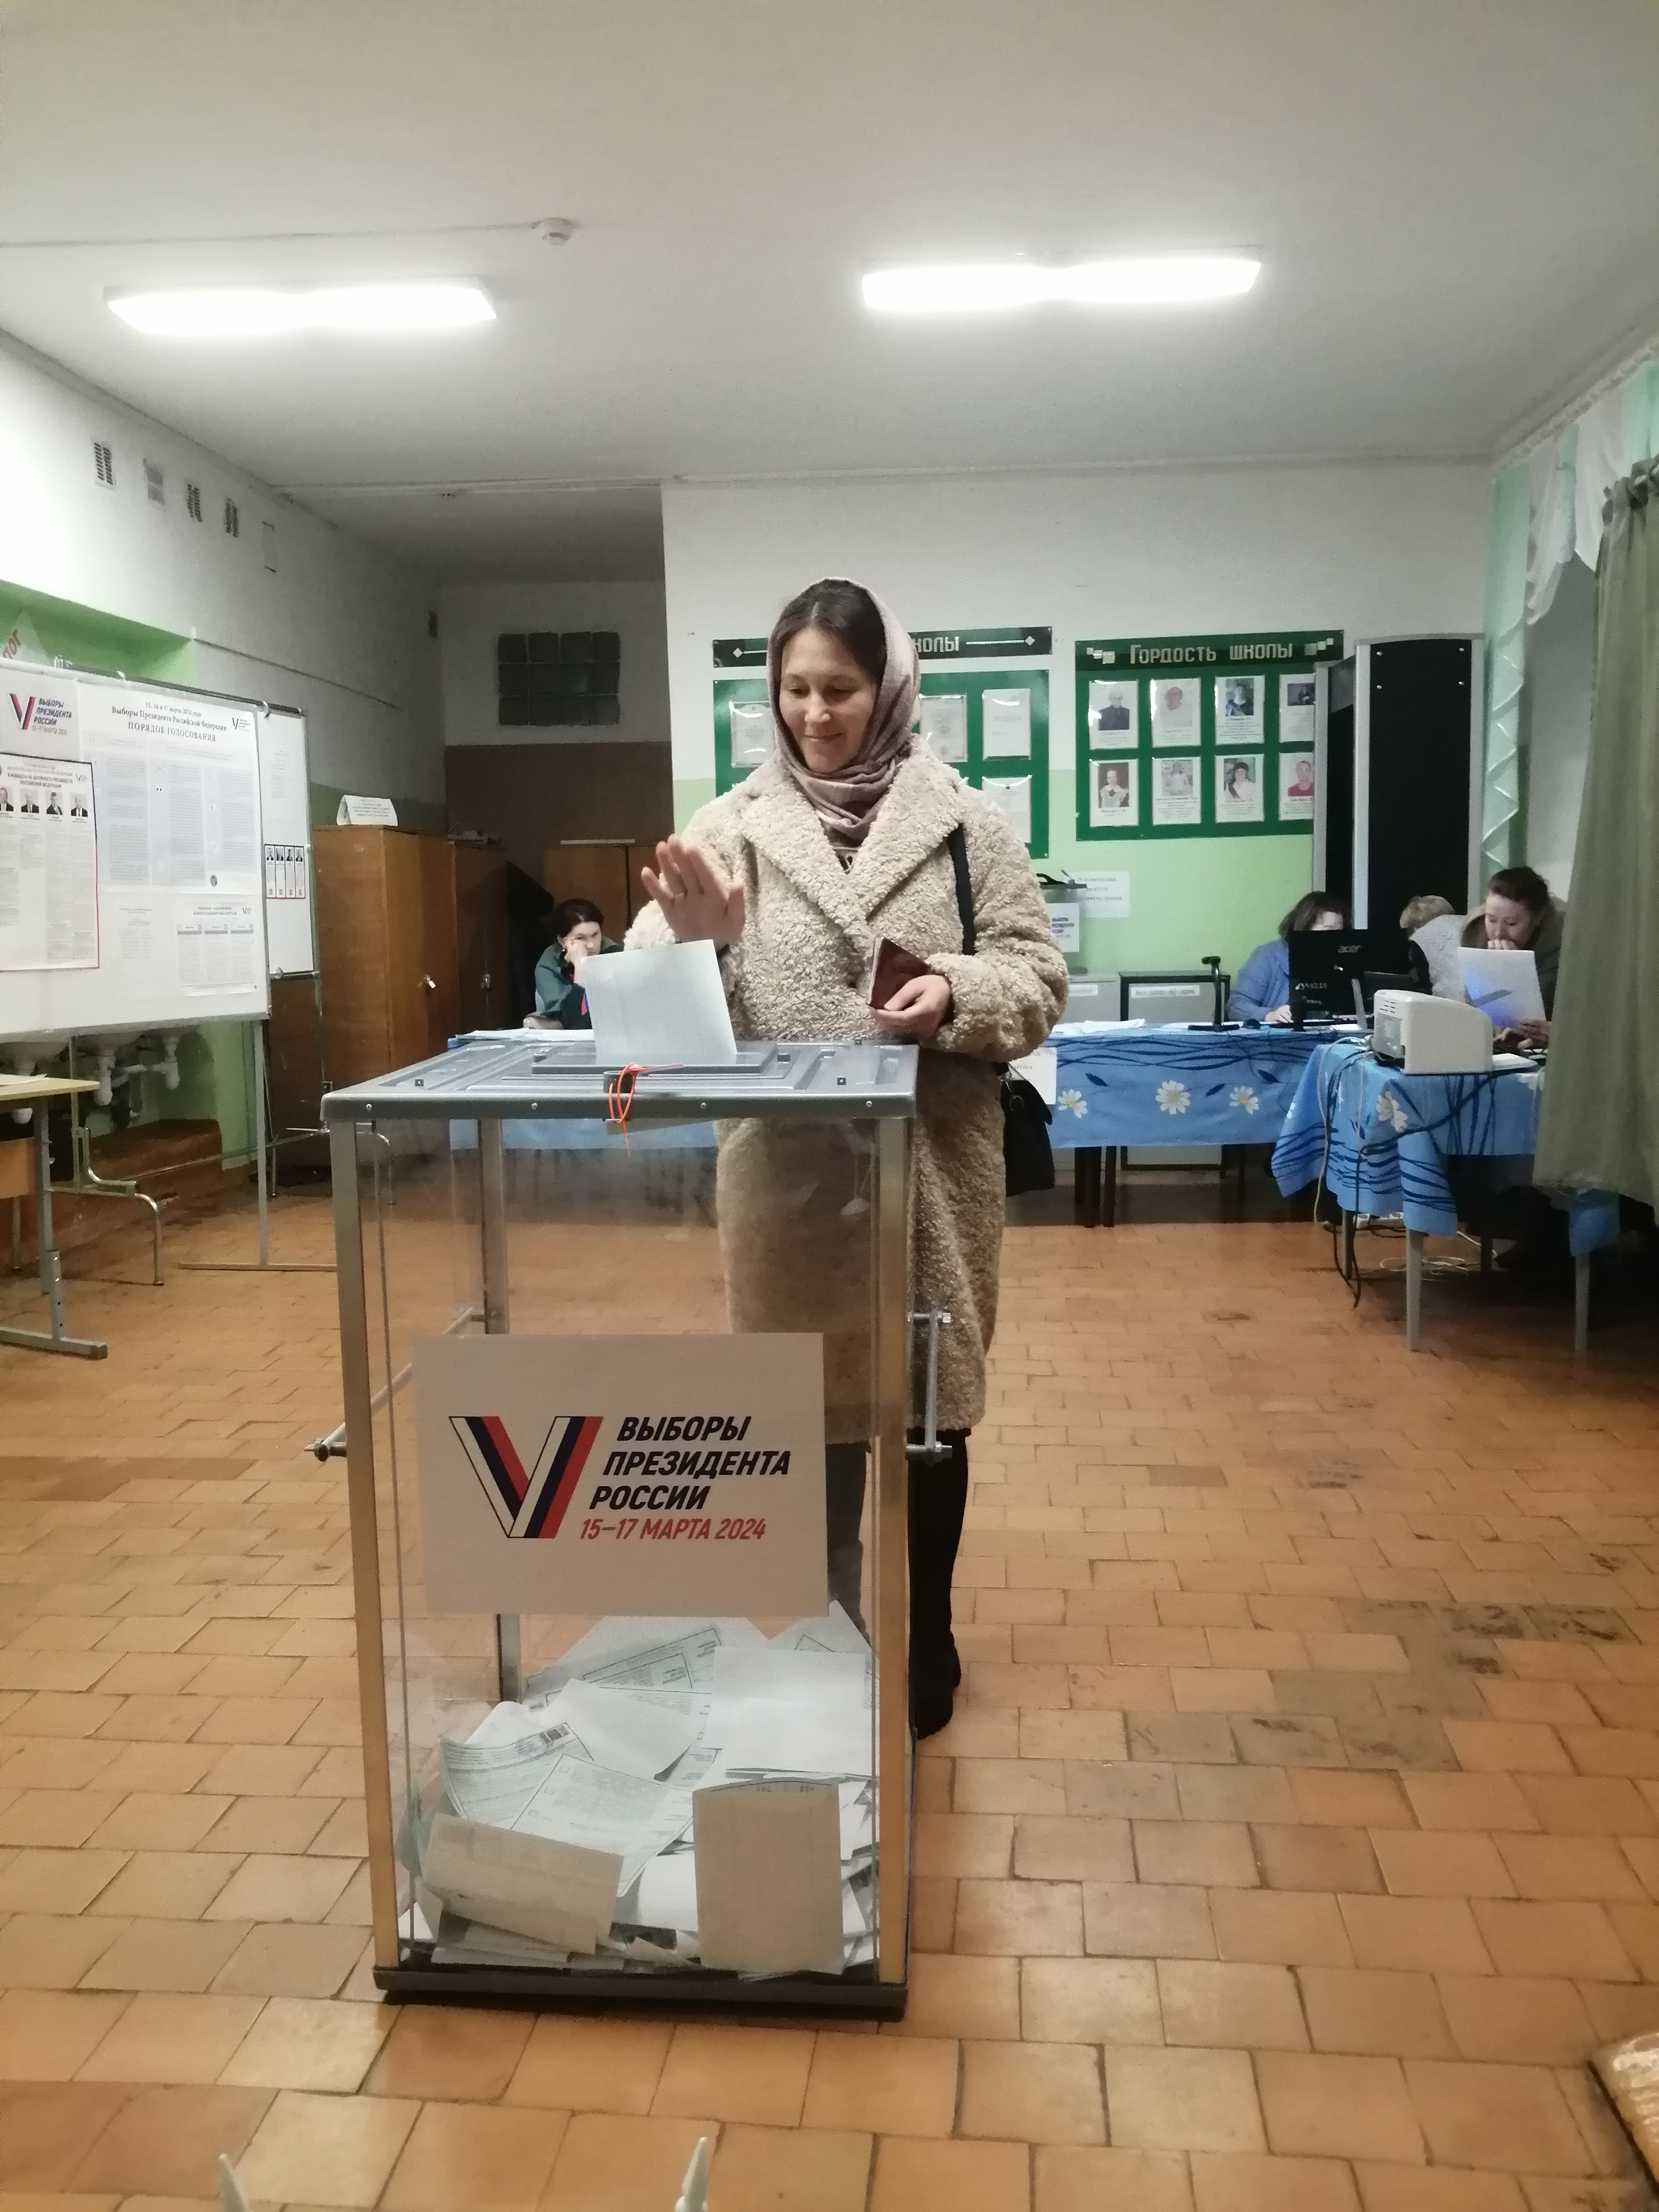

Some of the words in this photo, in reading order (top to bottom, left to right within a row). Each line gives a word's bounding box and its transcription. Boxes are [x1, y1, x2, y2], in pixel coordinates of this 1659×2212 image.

[1229, 643, 1293, 660] школы
[36, 707, 72, 719] ПРЕЗИДЕНТА
[38, 698, 64, 708] ВЫБОРЫ
[33, 716, 57, 726] РОССИИ
[112, 706, 138, 718] Выборы
[140, 710, 171, 722] Президента
[172, 715, 200, 726] Российской
[128, 721, 165, 733] ПОРЯДОК
[167, 727, 216, 742] ГОЛОСОВАНИЯ
[616, 1416, 751, 1442] ВЫБОРЫ
[602, 1451, 791, 1479] ПРЕЗИДЕНТА
[589, 1485, 710, 1510] РОССИИ
[640, 1519, 710, 1540] МАРТА
[714, 1518, 766, 1540] 2024
